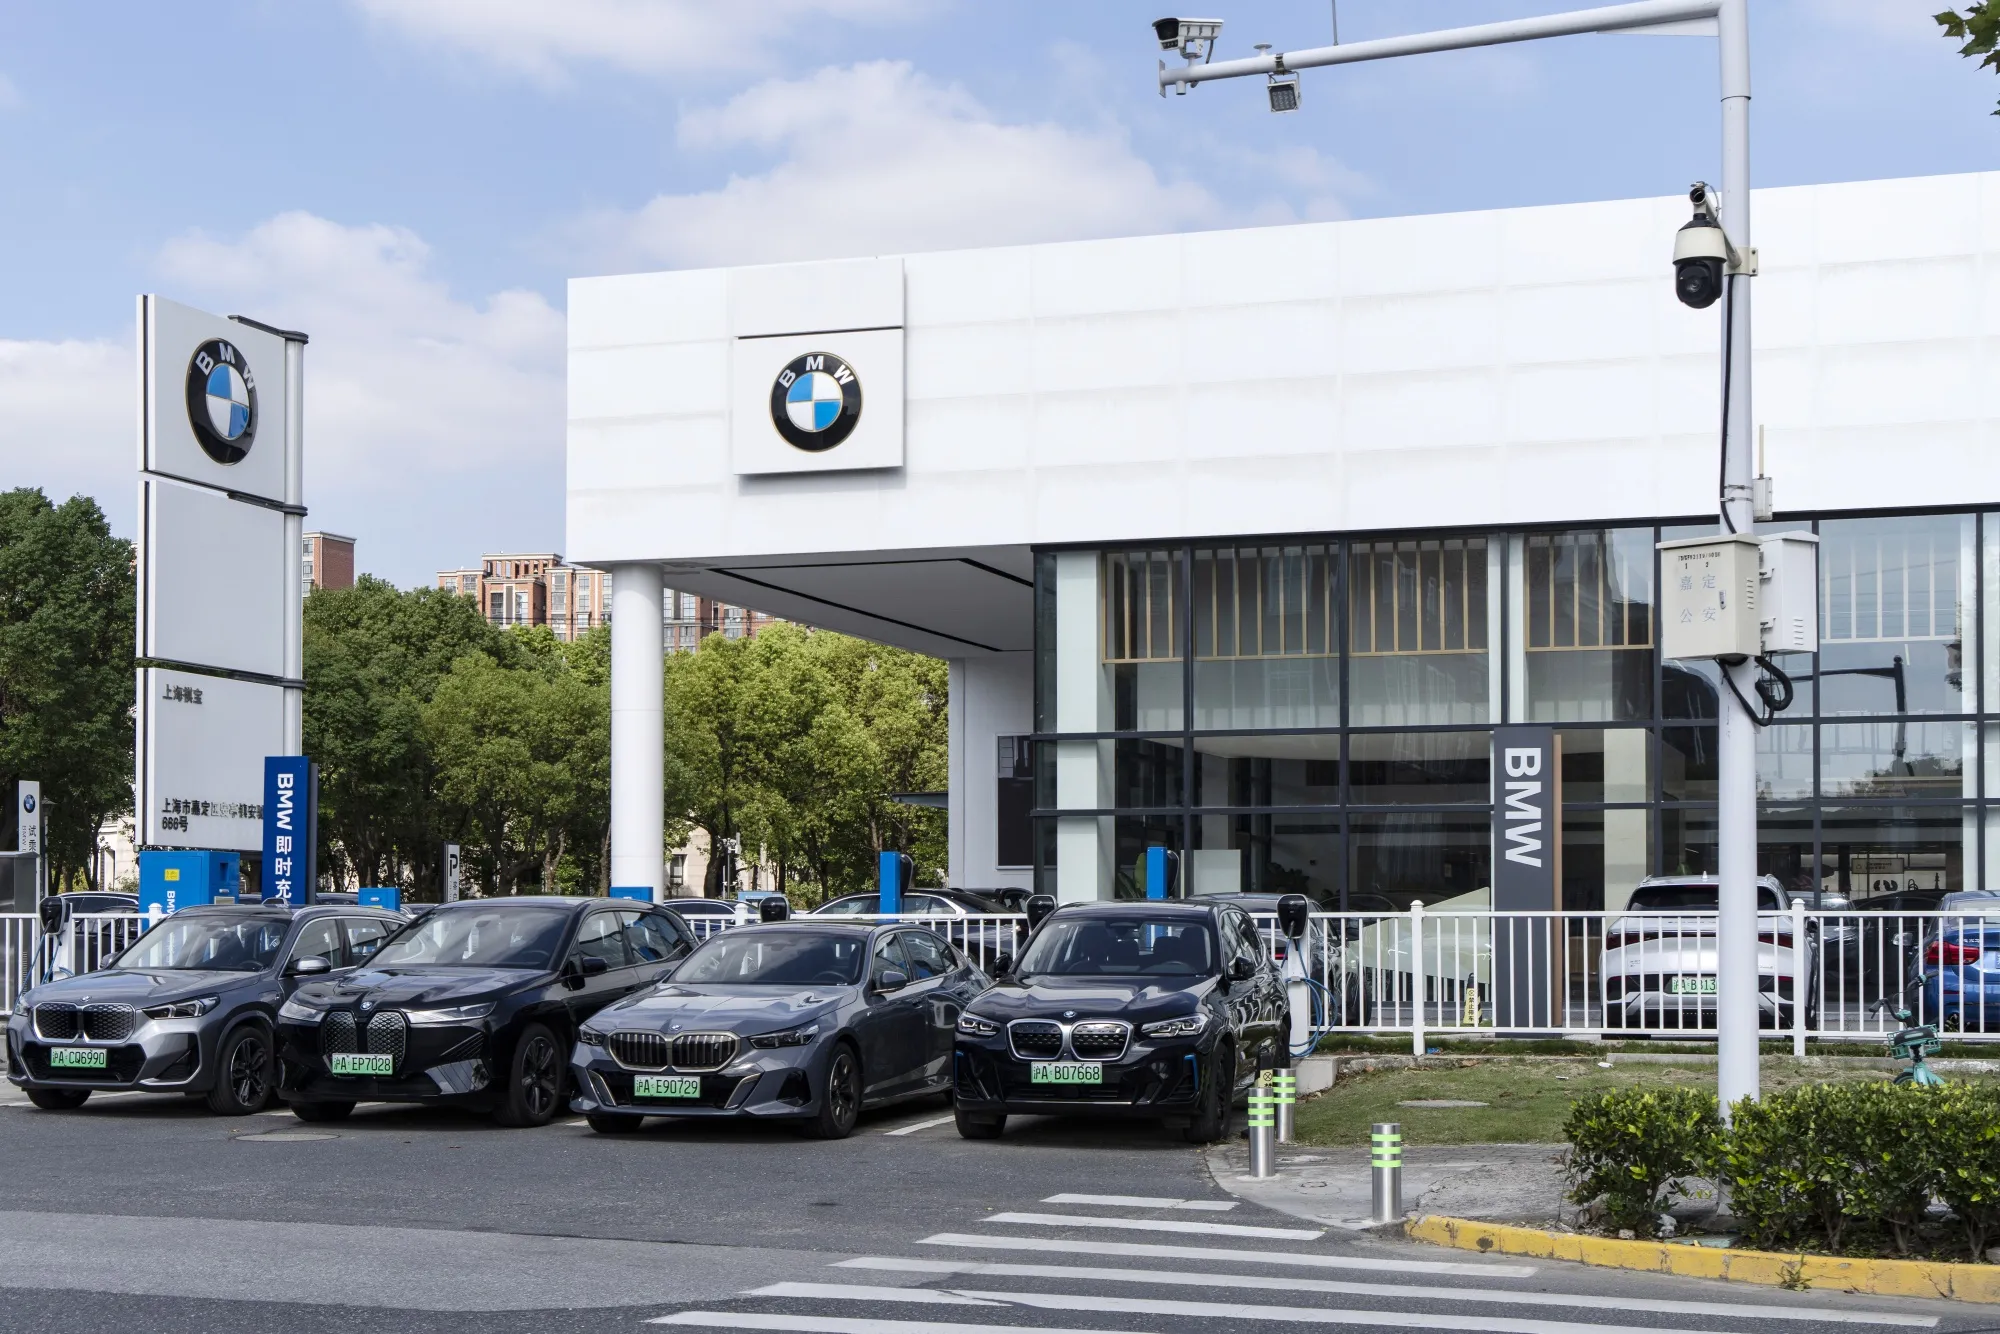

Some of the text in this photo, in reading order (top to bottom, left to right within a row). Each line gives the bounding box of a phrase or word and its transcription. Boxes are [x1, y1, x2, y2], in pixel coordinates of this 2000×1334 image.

[195, 342, 255, 390] BMW
[778, 355, 855, 388] BMW
[1680, 574, 1716, 591] 嘉定
[1680, 606, 1716, 623] 公安
[1505, 748, 1542, 868] BMW
[162, 816, 189, 833] 666号
[274, 773, 294, 899] BMW 即时充
[450, 853, 458, 877] P
